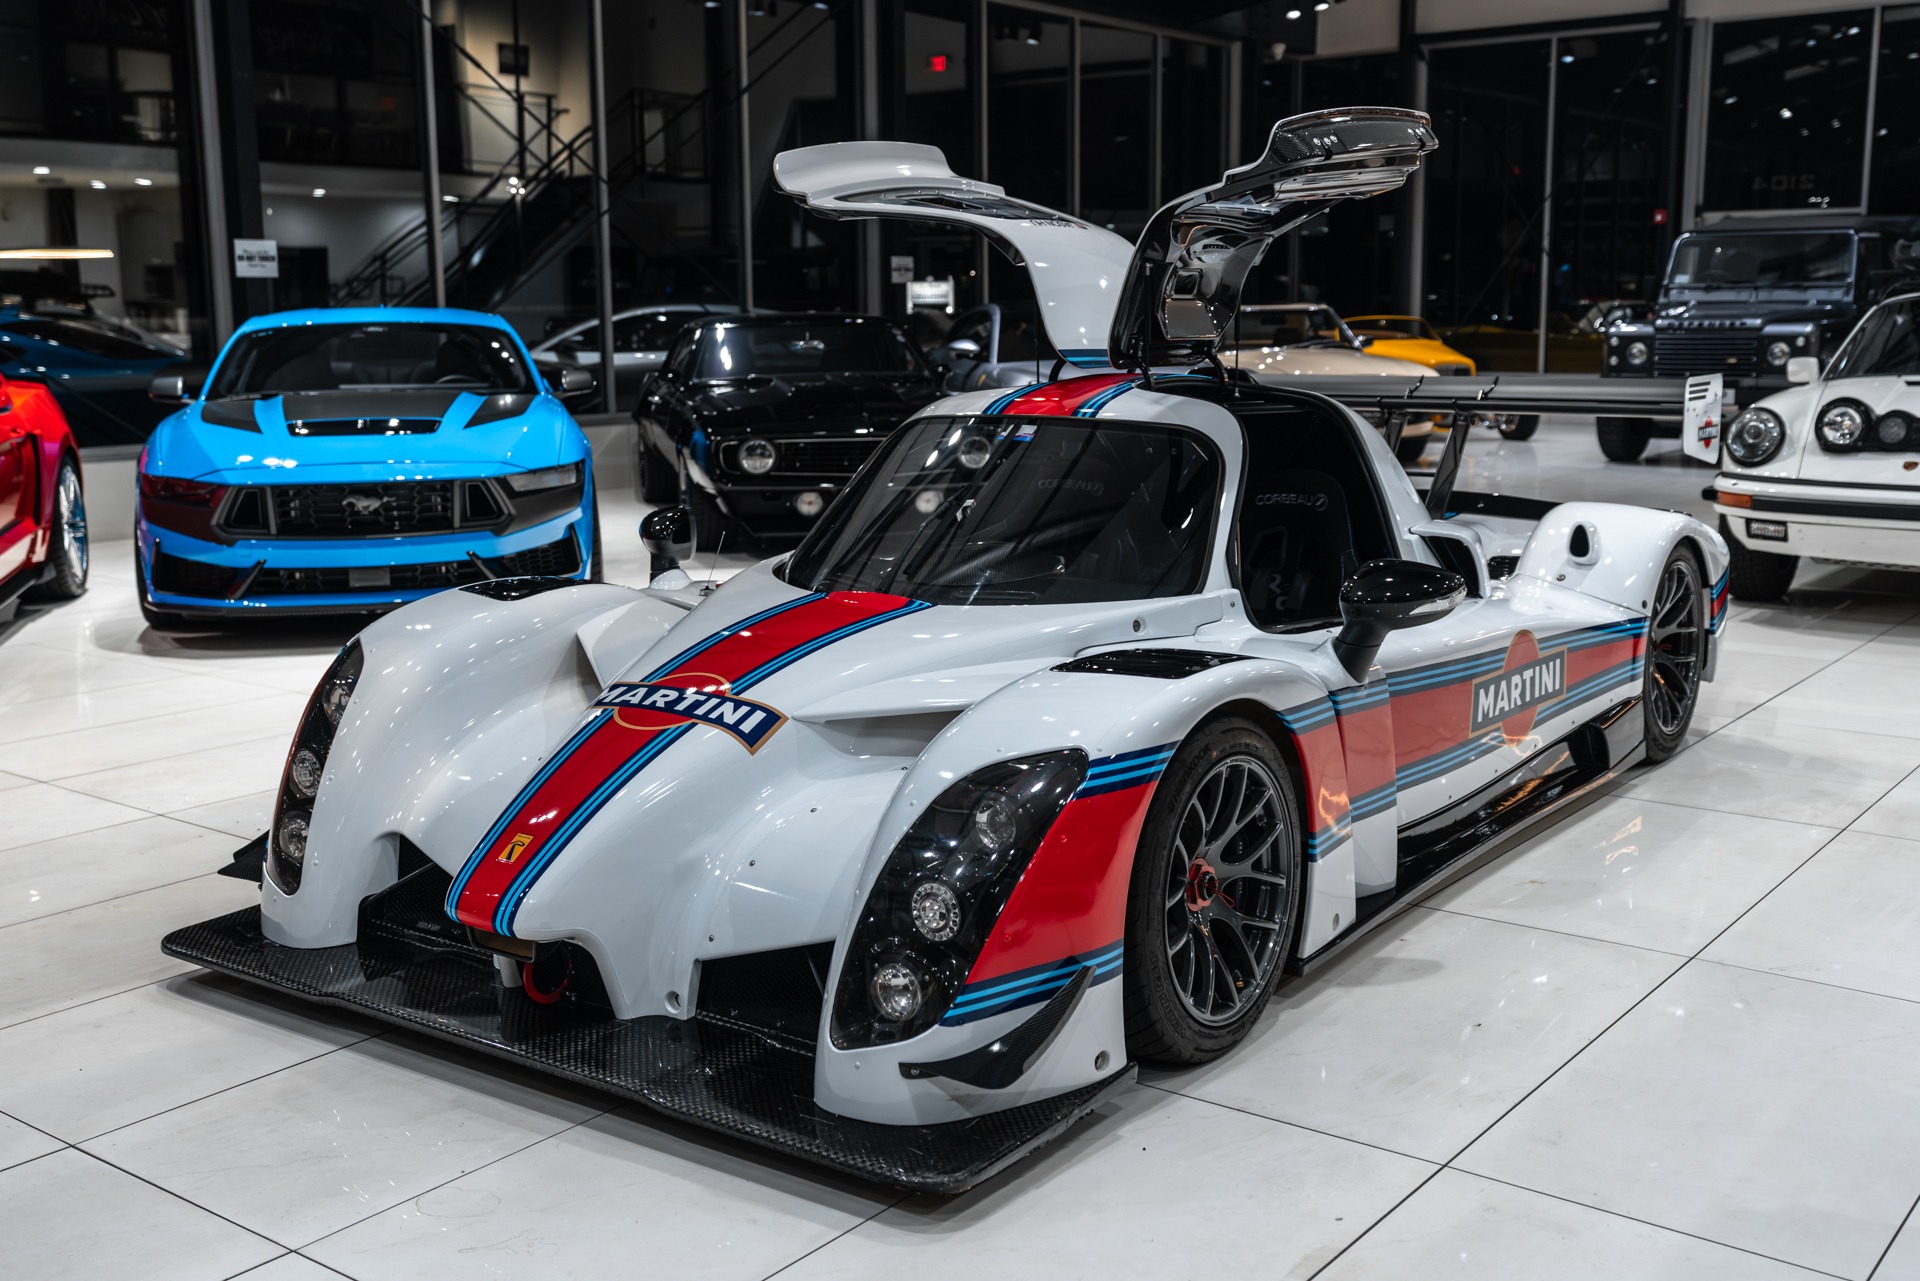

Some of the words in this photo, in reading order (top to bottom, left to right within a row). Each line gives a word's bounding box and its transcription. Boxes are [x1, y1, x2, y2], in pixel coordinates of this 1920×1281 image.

[1255, 493, 1314, 506] CORBEAU
[599, 686, 767, 734] MARTINI
[1477, 658, 1561, 723] MARTINI
